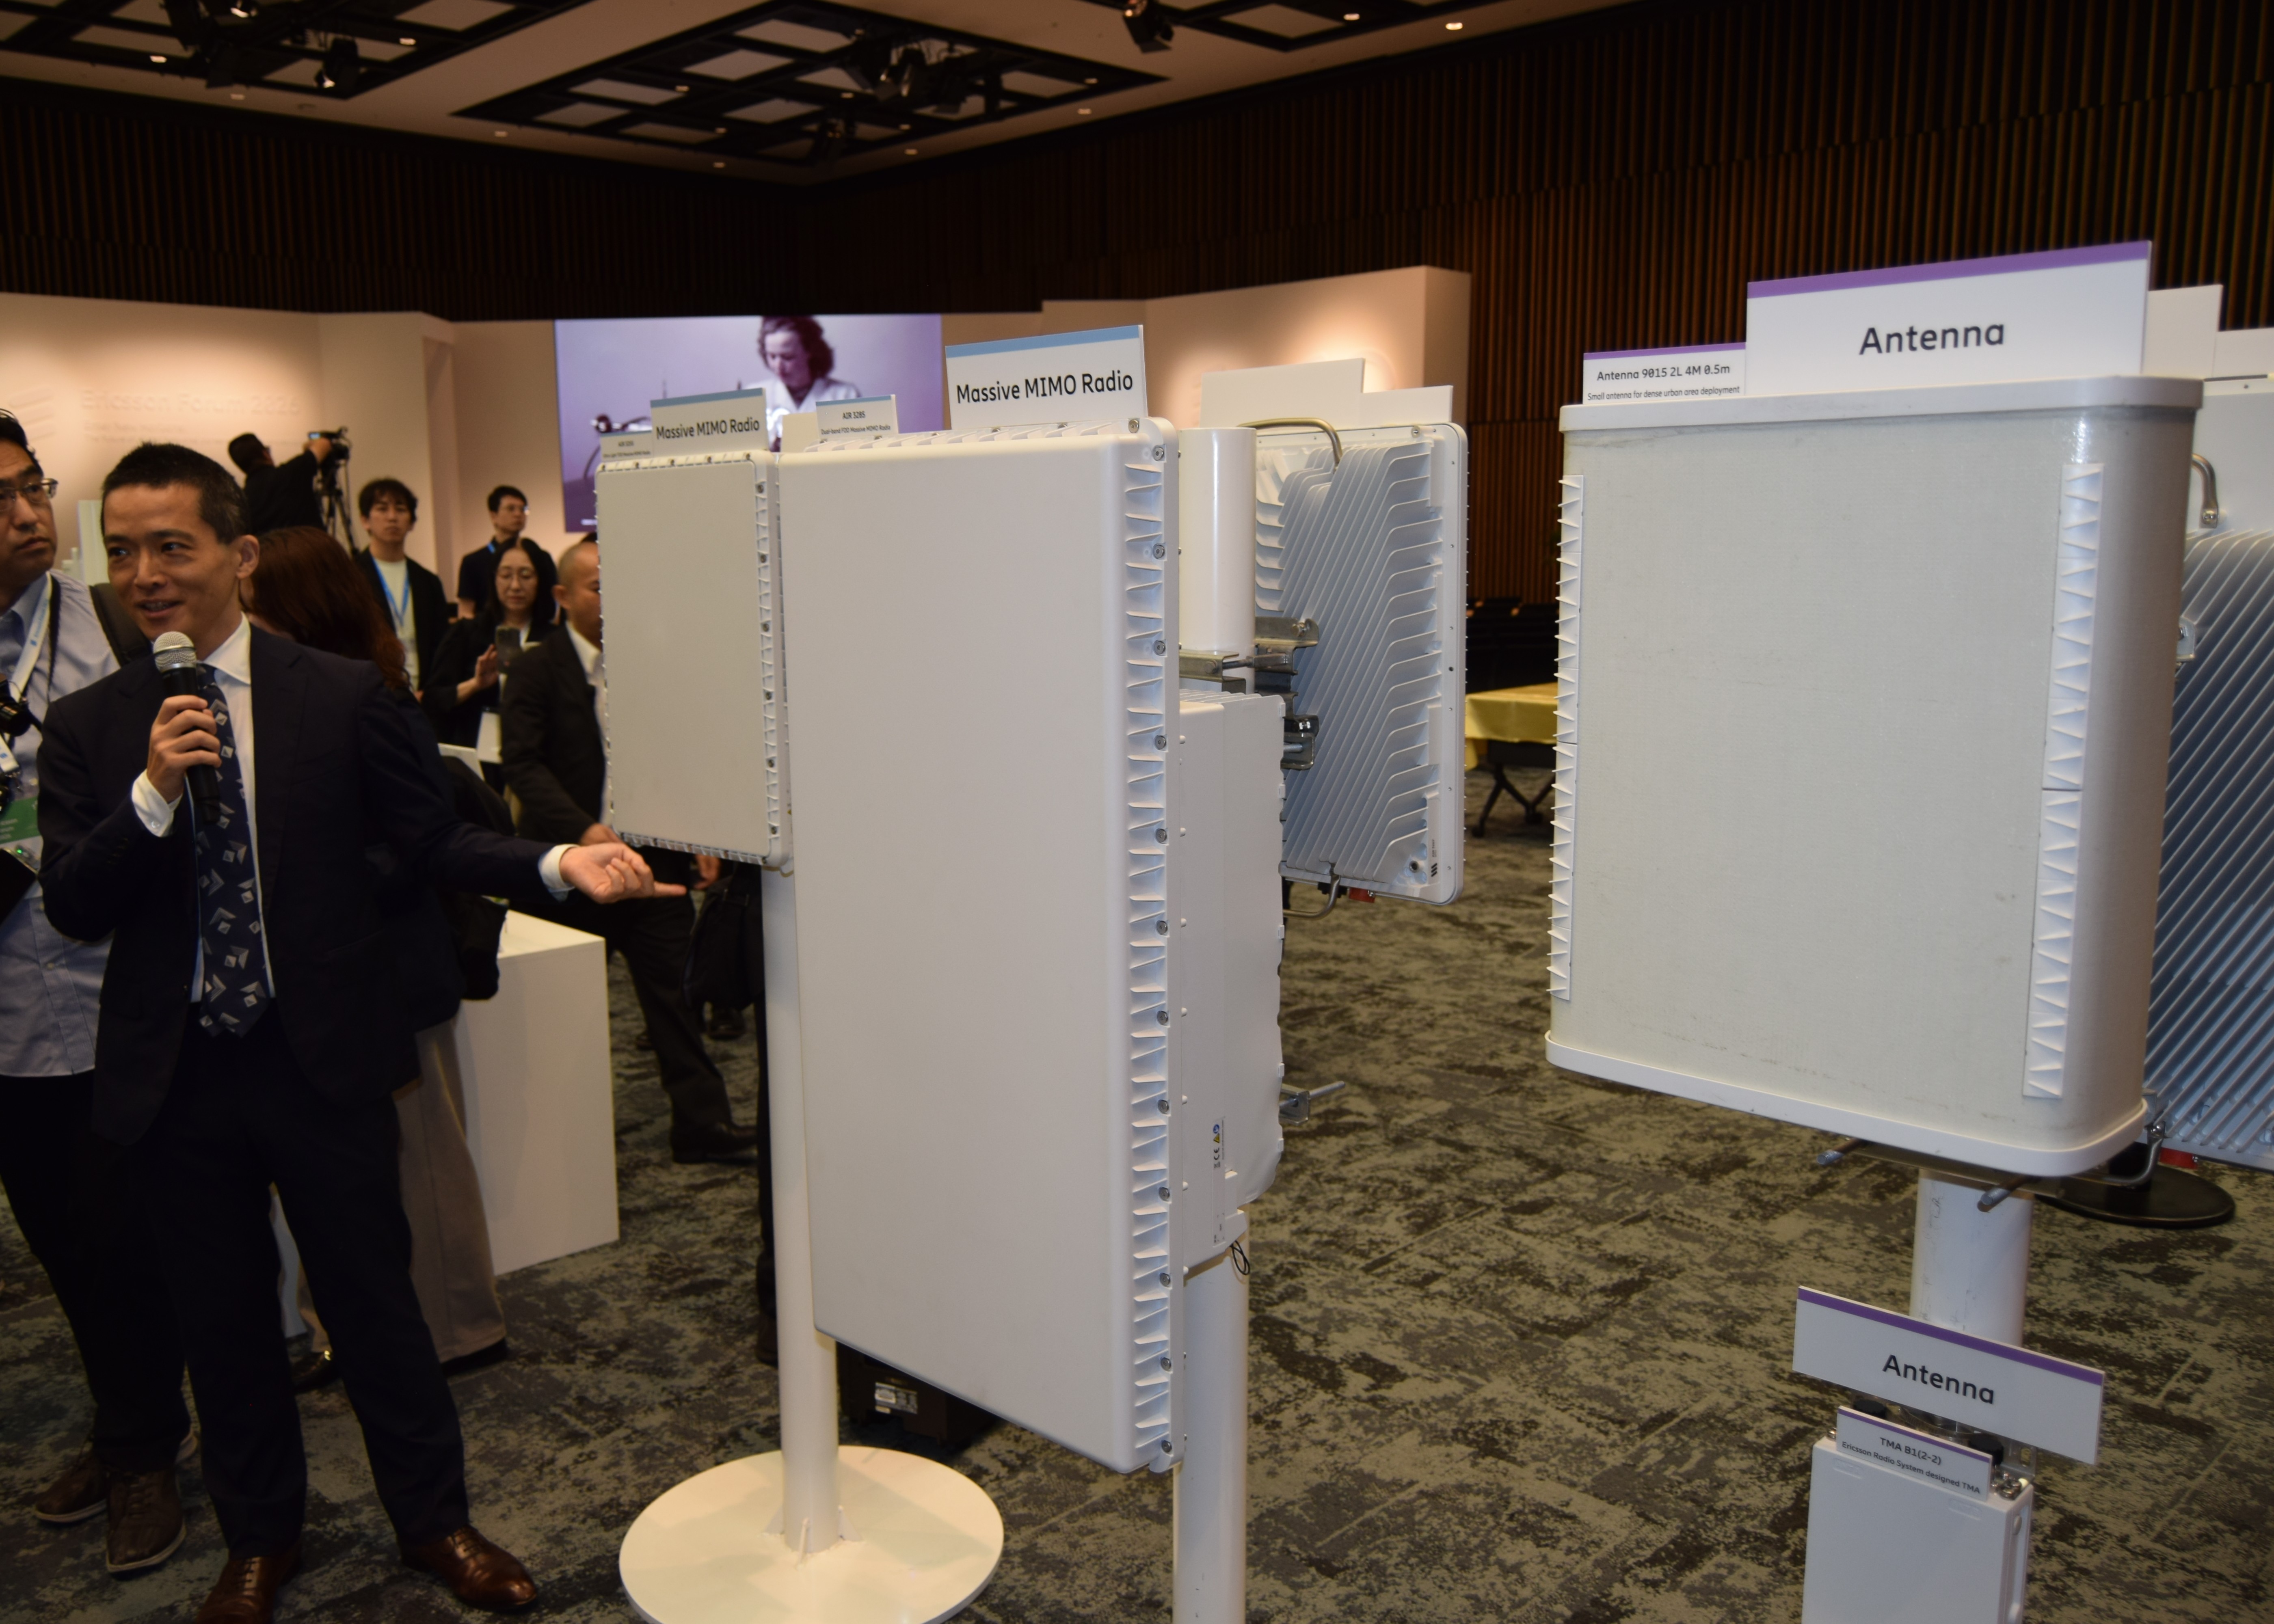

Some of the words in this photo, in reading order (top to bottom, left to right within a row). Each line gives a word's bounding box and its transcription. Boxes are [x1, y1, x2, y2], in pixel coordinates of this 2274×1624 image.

[1859, 324, 2004, 355] Antenna
[956, 380, 1020, 404] Massive
[1025, 374, 1076, 398] MIMO
[1082, 369, 1133, 393] Radio
[1597, 370, 1639, 381] Antenna
[1642, 367, 1667, 378] 9015
[1670, 367, 1682, 377] 2L
[1685, 365, 1701, 376] 4M
[1704, 364, 1730, 375] 0.5m
[1587, 392, 1605, 400] Small
[1606, 391, 1632, 400] antenna
[1633, 390, 1642, 398] for
[1643, 389, 1662, 398] dense
[1664, 388, 1683, 397] urban
[1700, 386, 1740, 397] deployment
[656, 423, 695, 440] Massive
[697, 420, 727, 436] MIMO
[729, 417, 760, 433] Radio
[1882, 1354, 1995, 1405] Antenna
[1879, 1437, 1902, 1451] TMA
[1904, 1445, 1942, 1466] B1(2-2)
[1842, 1441, 1872, 1457] Ericsson
[1873, 1452, 1895, 1465] Radio
[1896, 1460, 1924, 1475] System
[1925, 1470, 1960, 1488] designed
[1962, 1481, 1980, 1494] TMA
